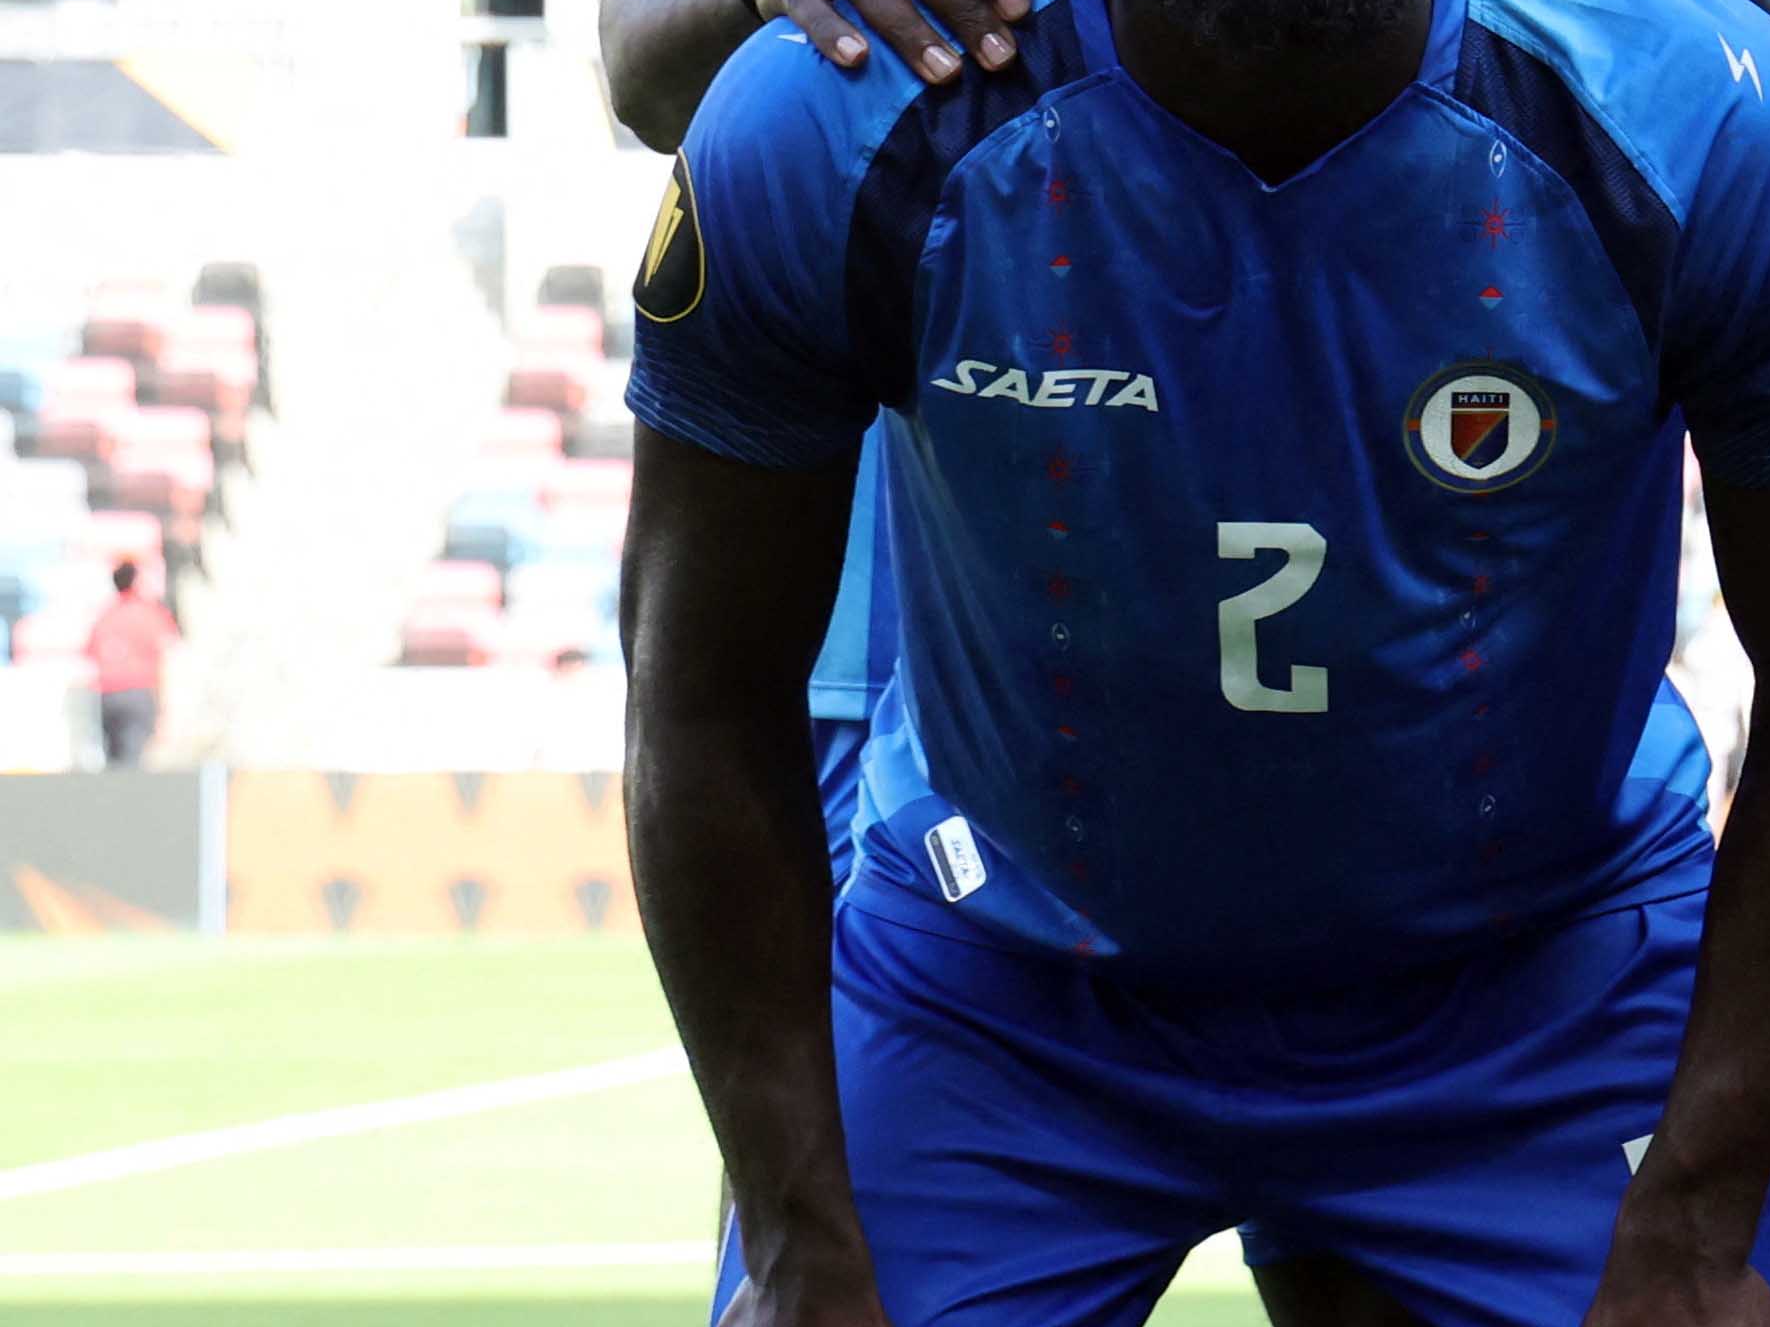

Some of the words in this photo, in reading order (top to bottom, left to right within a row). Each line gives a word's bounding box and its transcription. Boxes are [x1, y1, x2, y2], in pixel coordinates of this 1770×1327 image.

[931, 359, 1159, 412] SAETA
[1458, 394, 1503, 404] HAITI
[1217, 522, 1328, 713] 2
